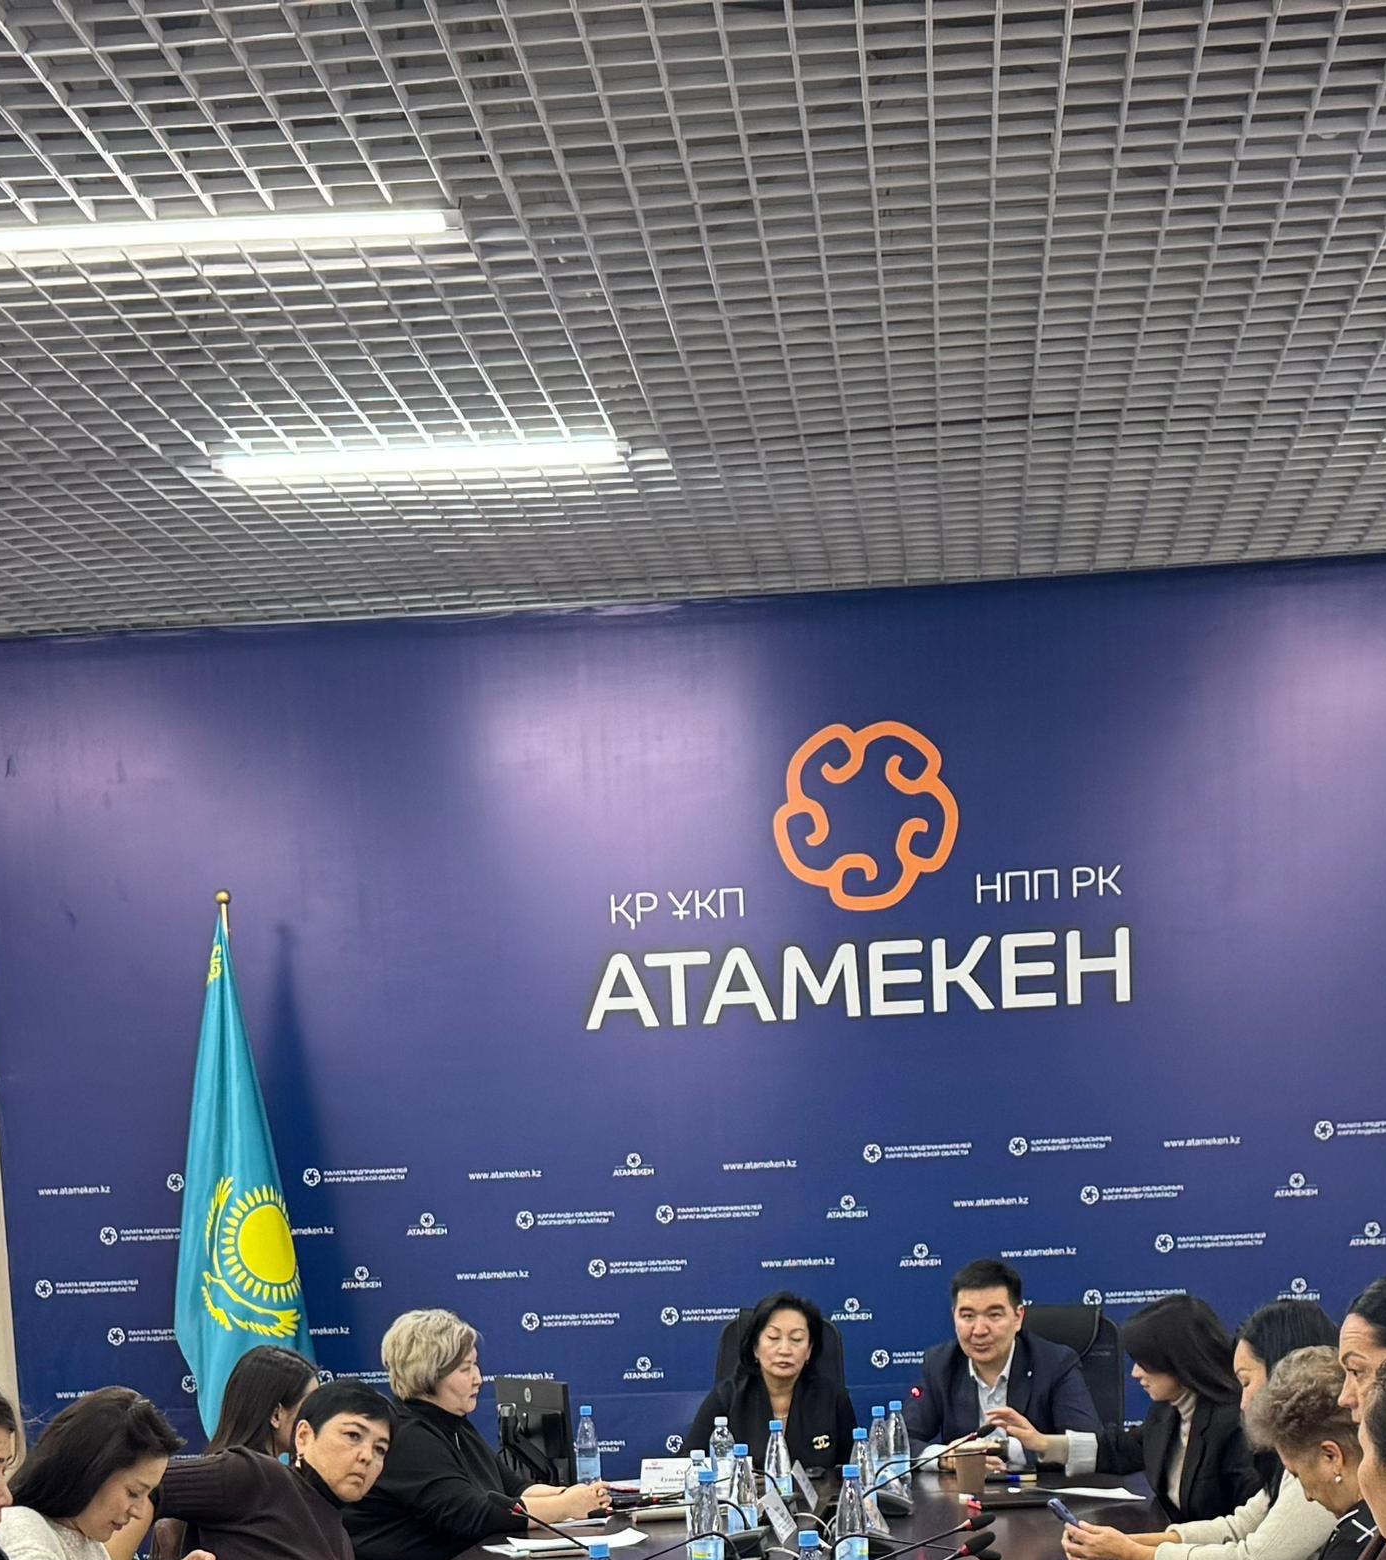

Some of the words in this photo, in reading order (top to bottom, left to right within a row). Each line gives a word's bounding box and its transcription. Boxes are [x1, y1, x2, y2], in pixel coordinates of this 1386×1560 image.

[975, 868, 1060, 904] НПП
[1072, 864, 1123, 898] РК
[609, 891, 659, 930] ҚР
[667, 887, 745, 922] ҰКП
[586, 926, 1131, 1031] АТАМЕКЕН
[1163, 1135, 1241, 1148] www.atameken.kz
[722, 1159, 798, 1171] www.atameken.kz
[468, 1168, 542, 1180] www.atameken.kz
[612, 1167, 655, 1177] АТАМЕКЕН
[37, 1184, 111, 1196] www.atameken.kz
[1274, 1187, 1319, 1198] АТАМЕКЕН
[953, 1196, 1029, 1208] www.atameken.kz
[826, 1209, 869, 1219] АТАМЕКЕН
[291, 1226, 335, 1236] ameken.kz
[406, 1227, 448, 1236] АТАМЕКЕН
[1000, 1246, 1077, 1258] www.atameken.kz
[760, 1256, 836, 1268] www.atameken.kz
[899, 1257, 942, 1268] АТАМЕКЕН
[456, 1269, 530, 1281] www.atameken.kz
[341, 1280, 382, 1290] АТАМЕКЕН
[830, 1312, 873, 1322] АТАМЕКЕН
[622, 1371, 664, 1381] АТАМЕКЕН
